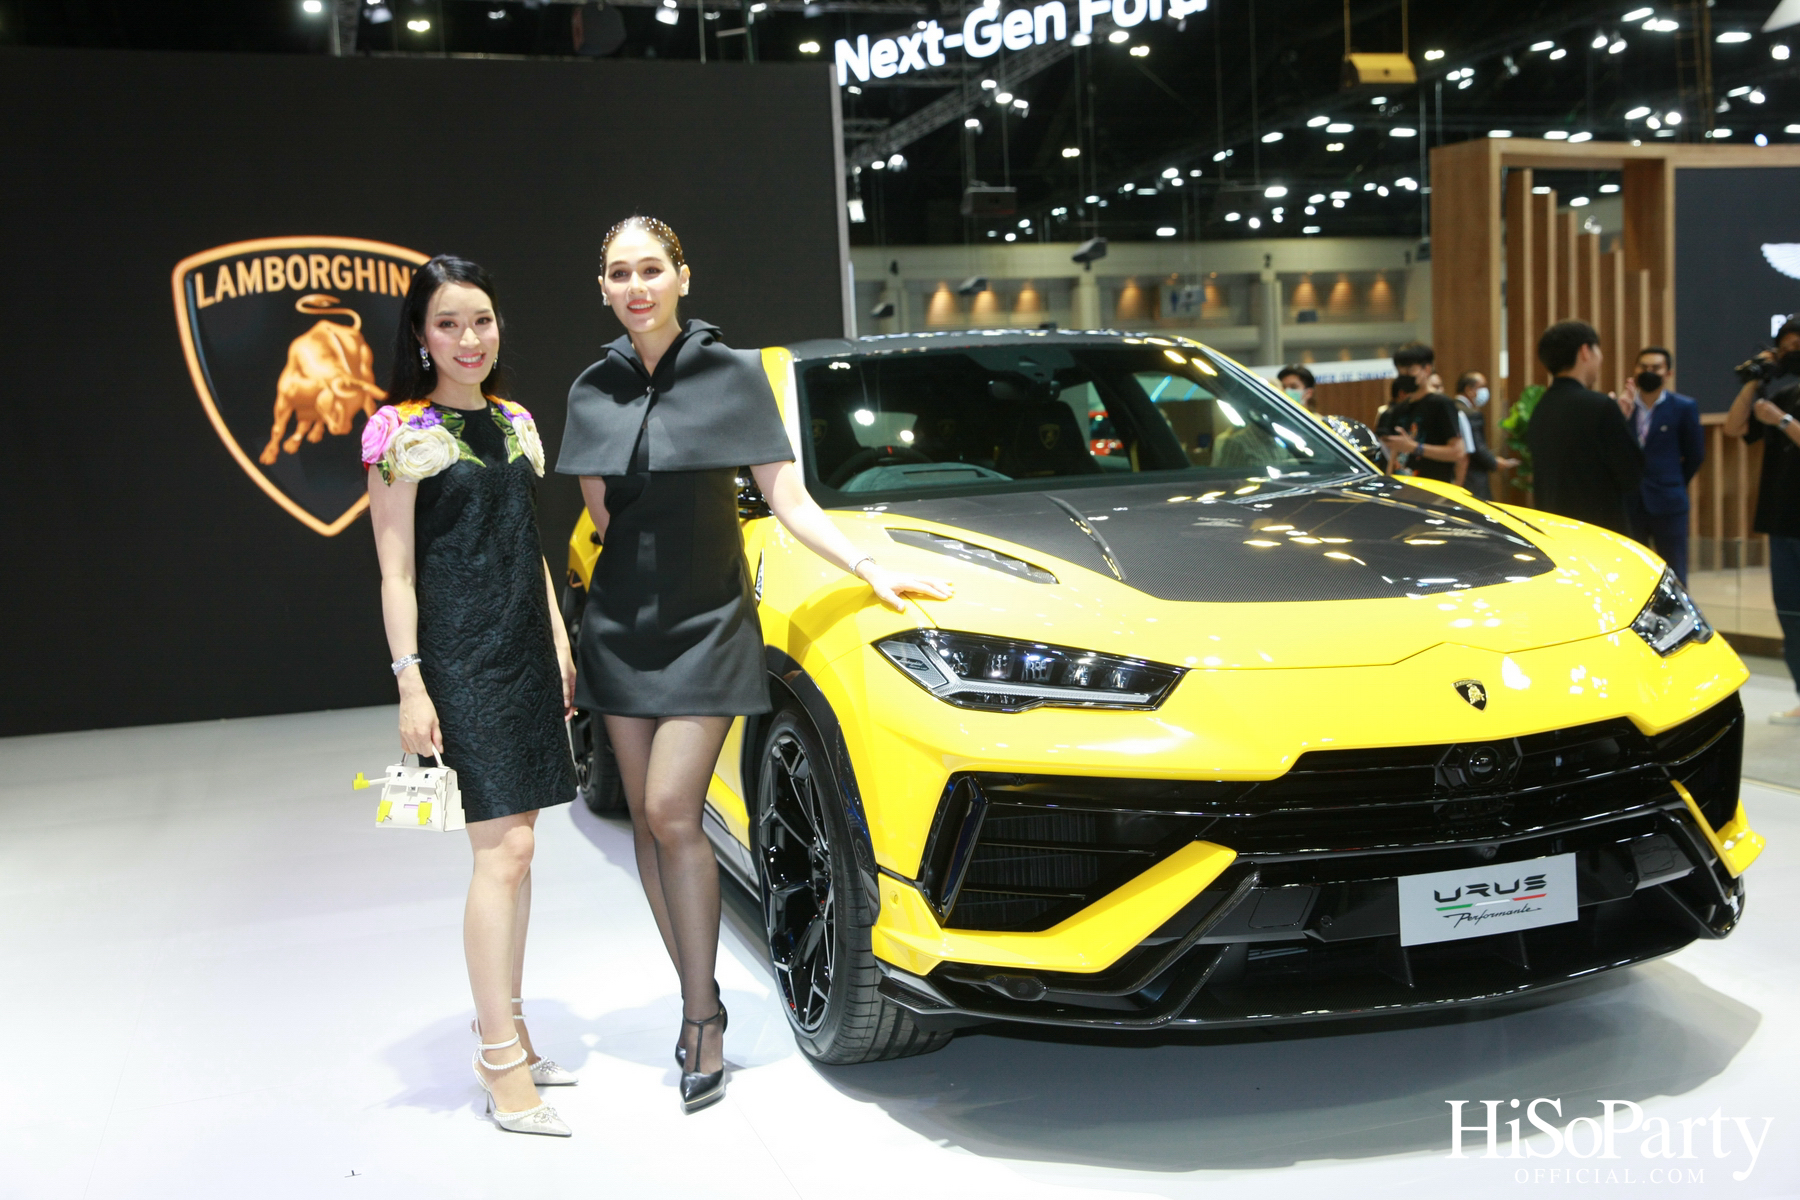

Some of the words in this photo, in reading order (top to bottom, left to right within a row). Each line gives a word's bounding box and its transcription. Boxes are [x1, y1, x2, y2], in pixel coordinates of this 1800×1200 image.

[835, 0, 1067, 86] Next-Gen
[194, 253, 418, 310] LAMBORGHIN
[1433, 873, 1548, 904] URUS
[1442, 903, 1543, 929] Performante
